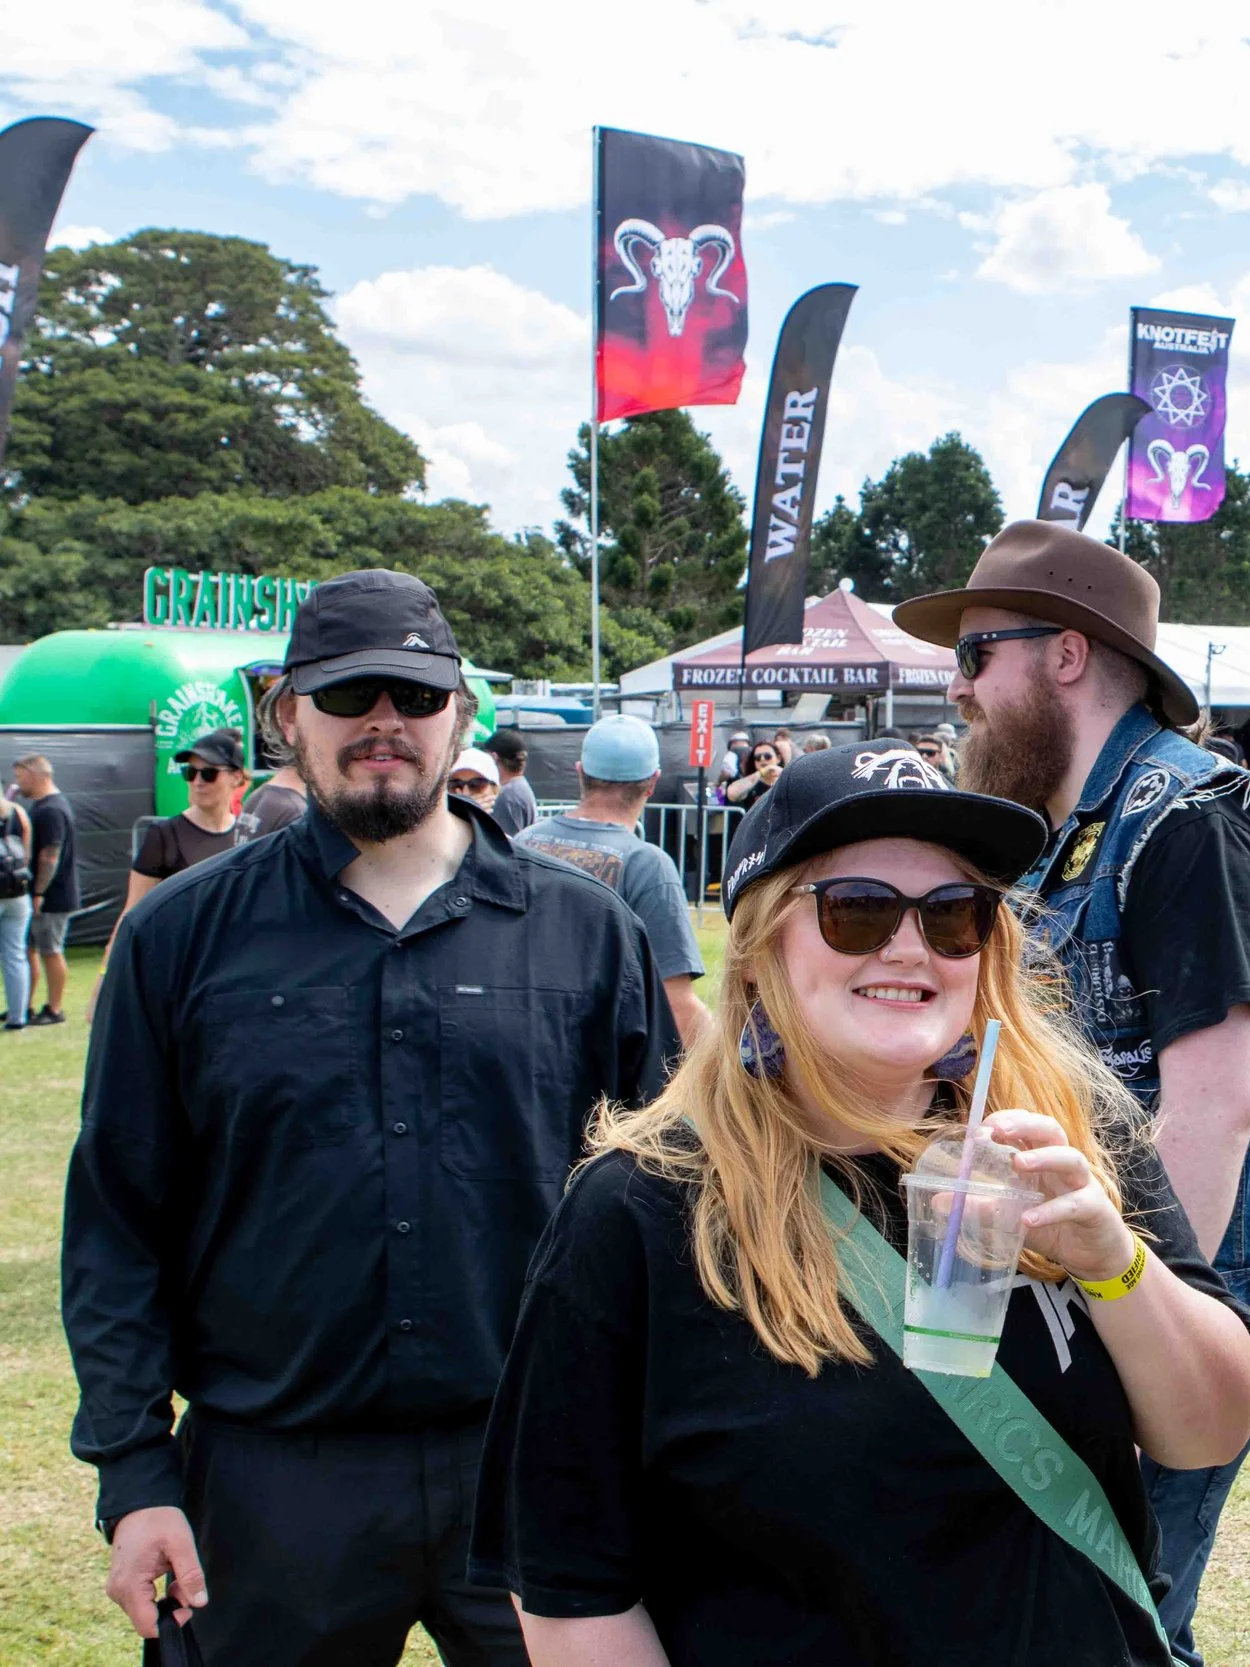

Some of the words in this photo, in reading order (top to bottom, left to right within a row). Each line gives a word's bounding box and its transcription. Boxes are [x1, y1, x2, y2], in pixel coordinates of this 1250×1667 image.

[765, 386, 819, 564] WATER
[682, 668, 745, 684] FROZEN
[752, 668, 837, 684] COCKTAIL
[844, 667, 878, 684] BAR
[696, 703, 709, 763] EXIT
